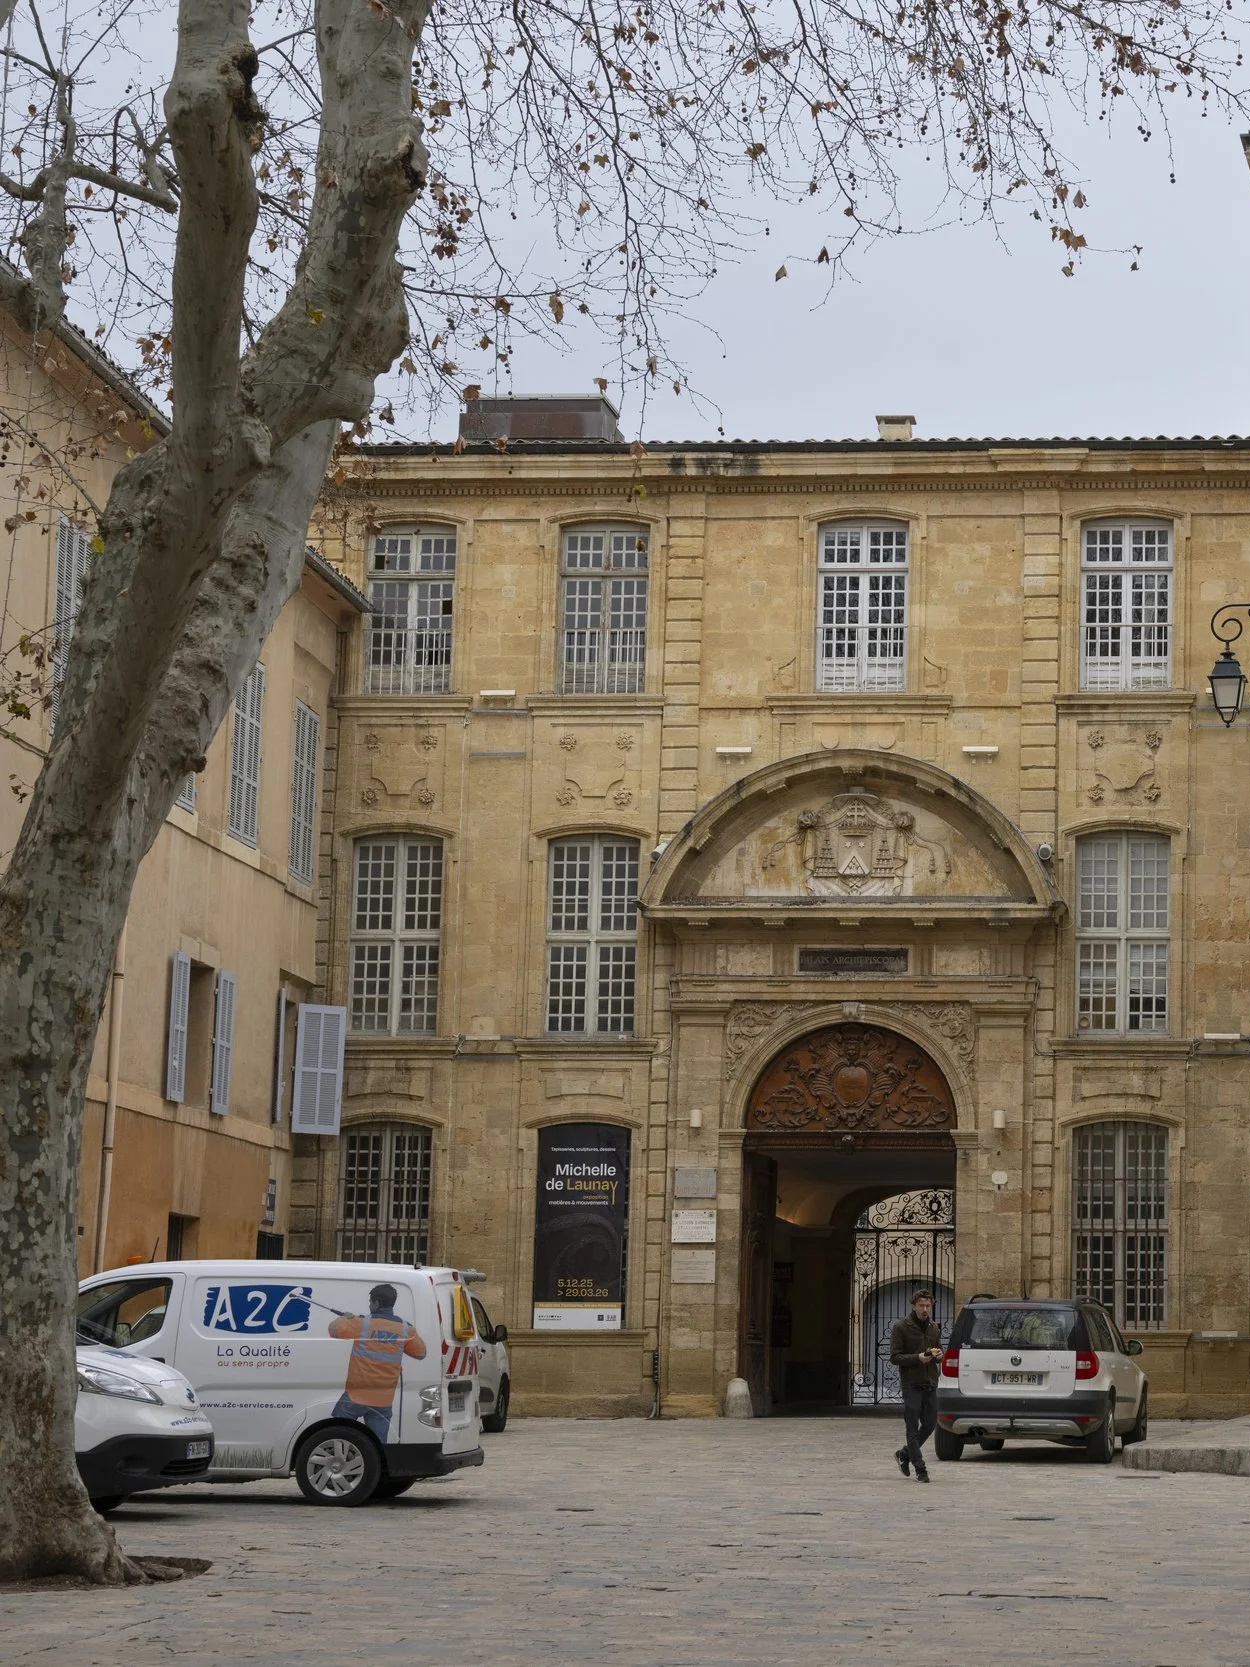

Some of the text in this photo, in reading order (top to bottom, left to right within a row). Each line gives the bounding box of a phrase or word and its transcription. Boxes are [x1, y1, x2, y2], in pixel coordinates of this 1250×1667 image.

[555, 1163, 616, 1176] Michelle
[545, 1177, 618, 1205] de Launay
[557, 1278, 593, 1288] 5.12.25
[565, 1288, 609, 1297] 29.03.26
[208, 1285, 306, 1332] A2C
[216, 1345, 291, 1357] La Qualité
[996, 1373, 1037, 1383] CT-951-WR
[199, 1401, 294, 1409] www.a2c-services.com
